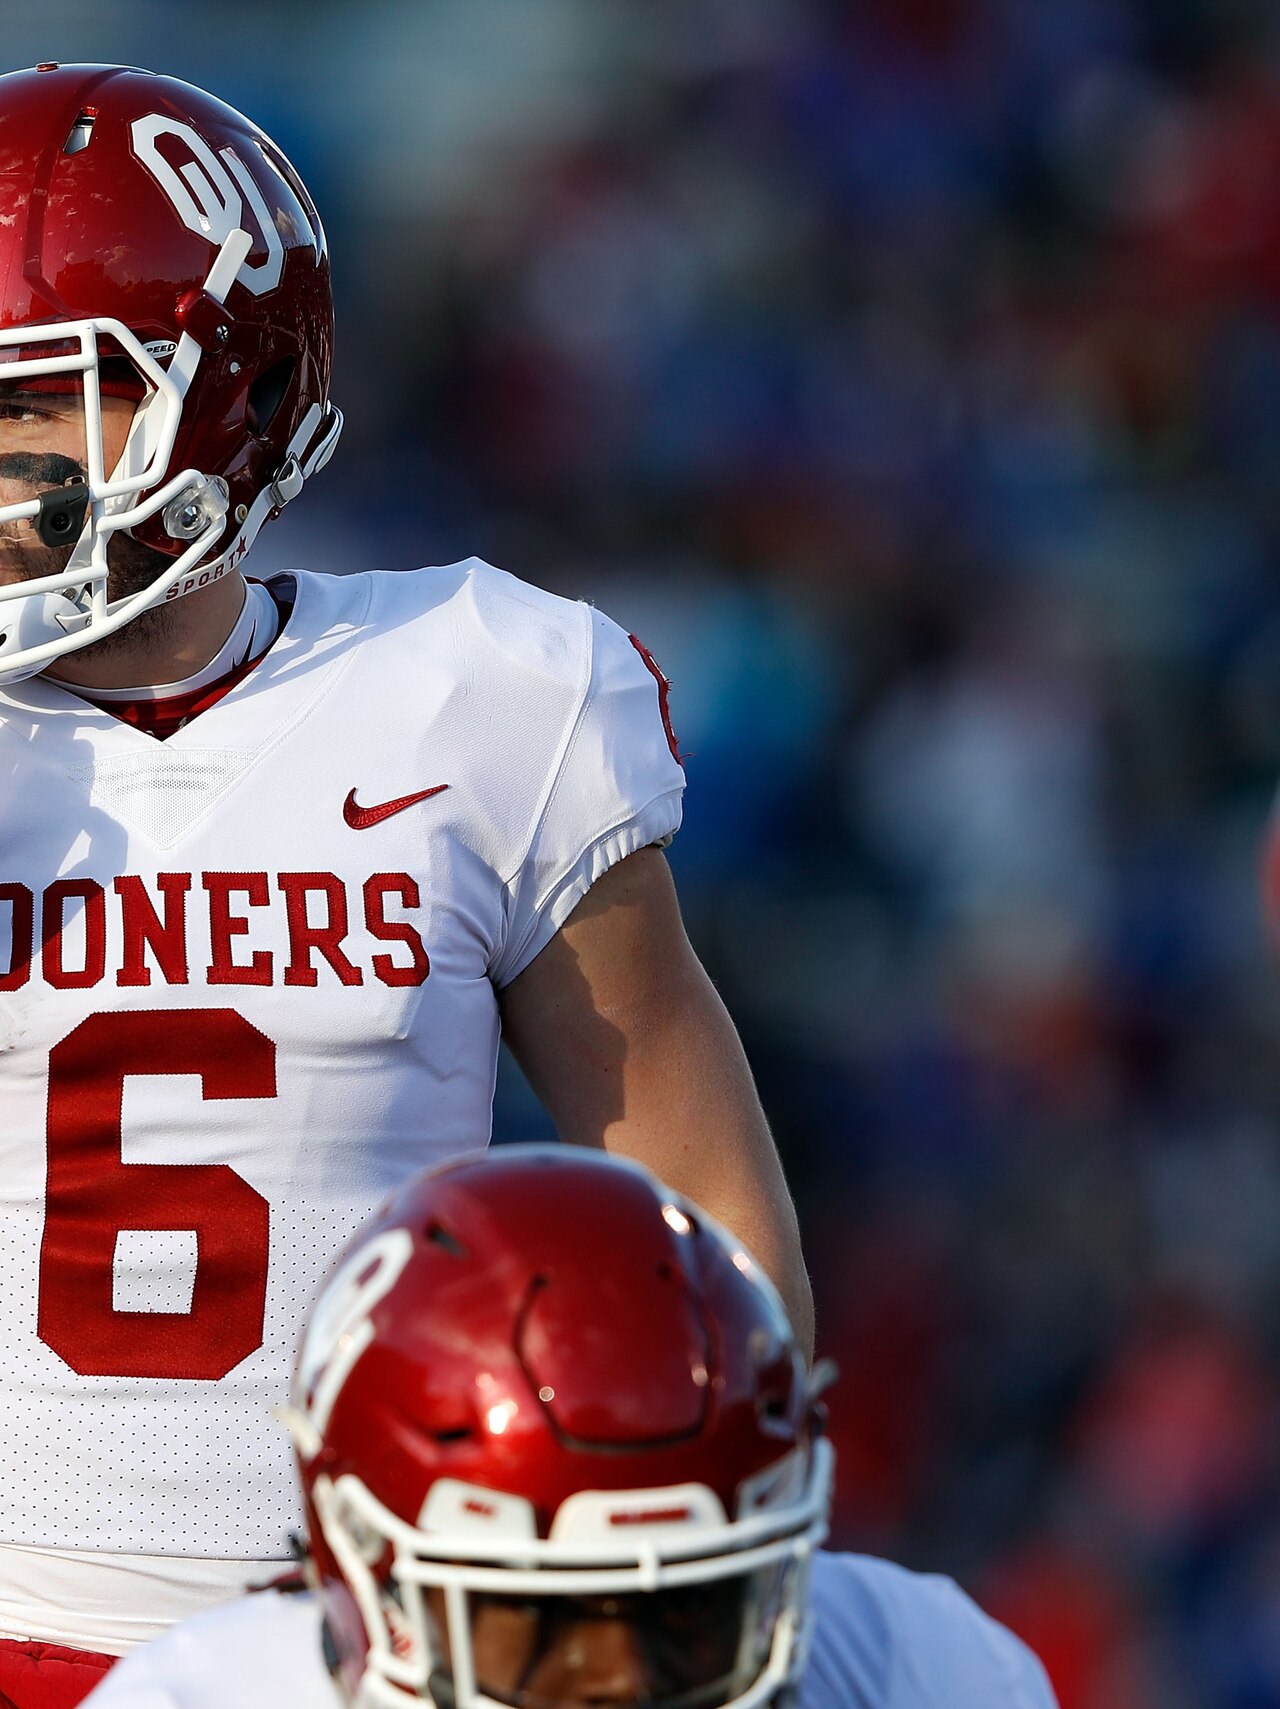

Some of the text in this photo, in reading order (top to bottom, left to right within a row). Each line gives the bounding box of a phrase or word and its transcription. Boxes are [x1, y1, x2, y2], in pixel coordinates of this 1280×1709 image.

[130, 113, 284, 297] OU
[145, 343, 177, 354] PEED
[37, 1007, 278, 1382] 6
